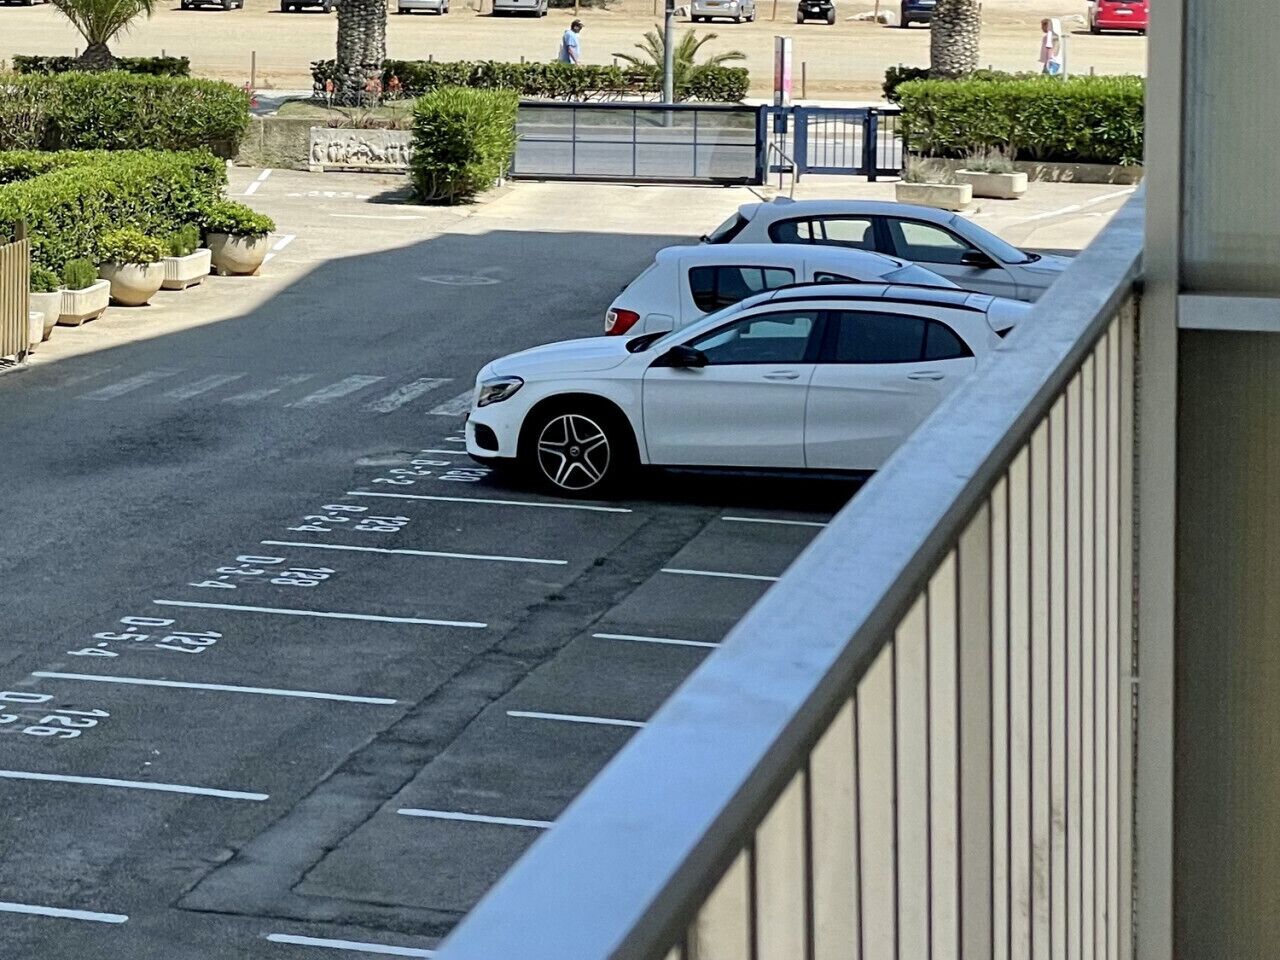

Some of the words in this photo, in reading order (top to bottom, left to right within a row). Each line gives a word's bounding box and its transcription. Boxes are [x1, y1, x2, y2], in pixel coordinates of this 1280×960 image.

[354, 515, 410, 532] 129
[270, 567, 336, 586] 128
[155, 630, 223, 653] 127
[23, 709, 111, 738] 126
